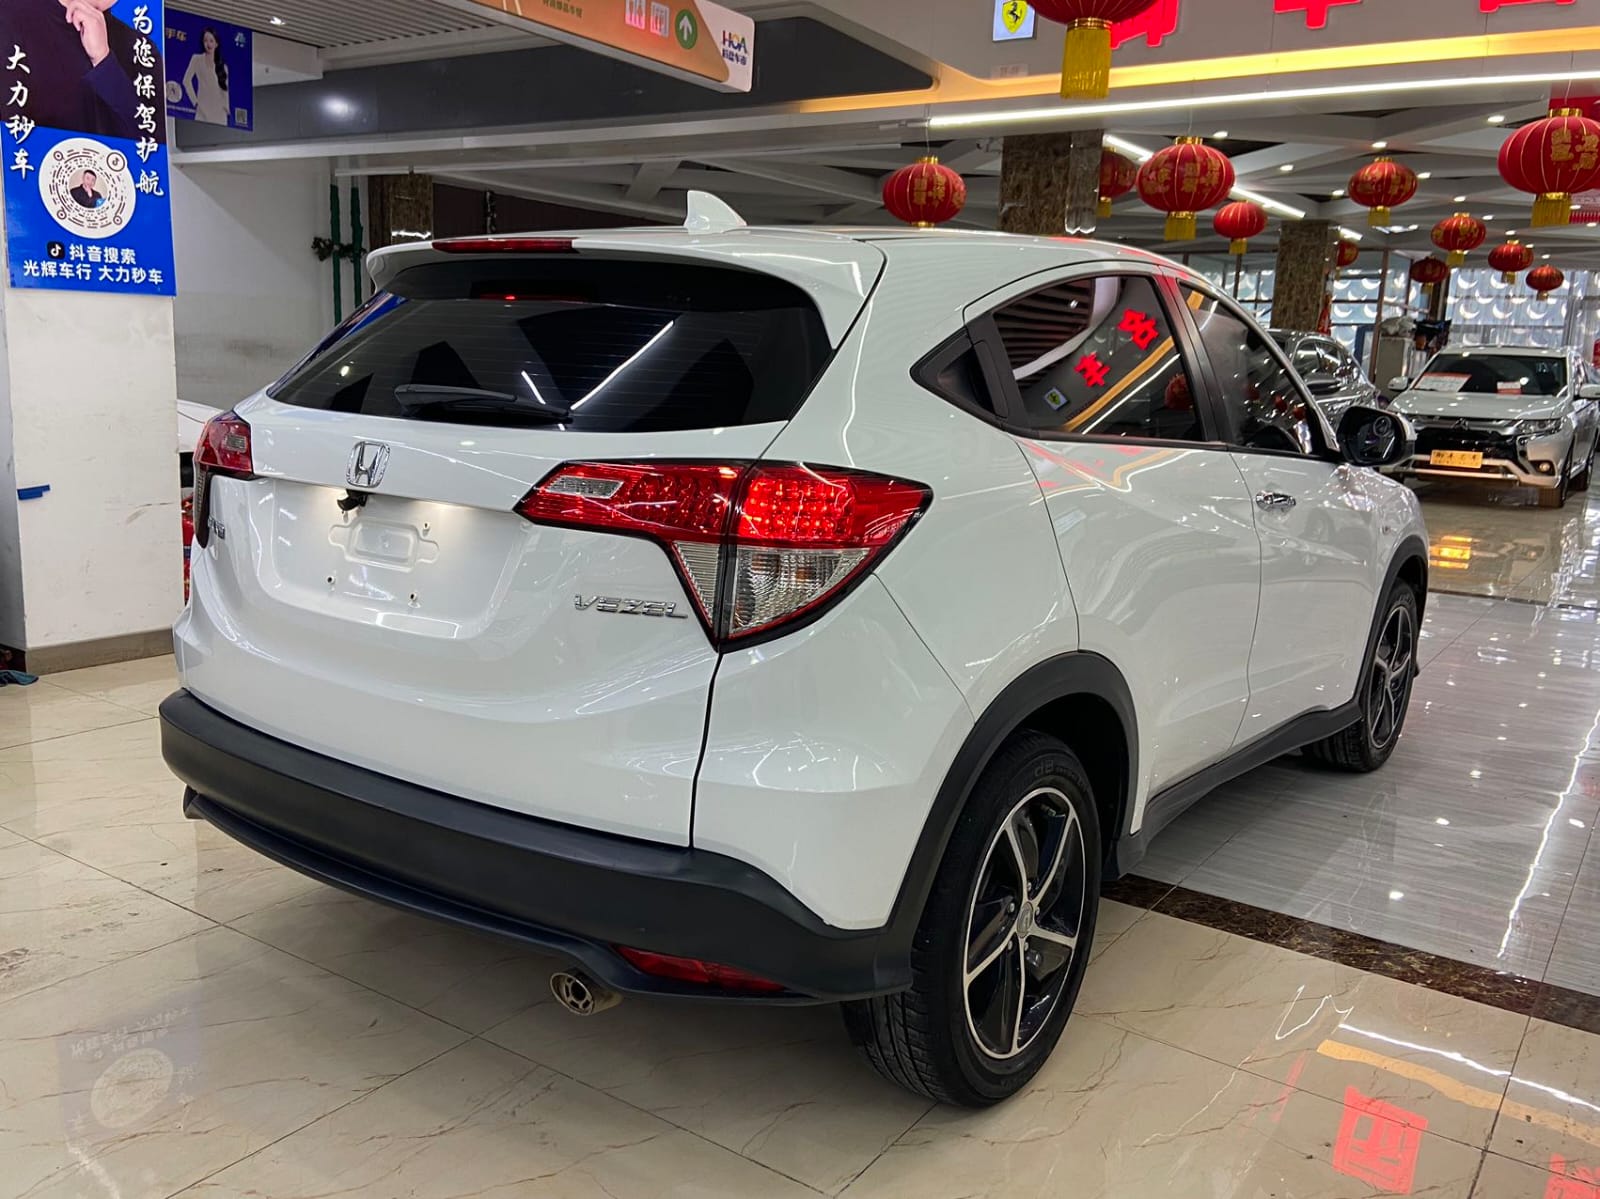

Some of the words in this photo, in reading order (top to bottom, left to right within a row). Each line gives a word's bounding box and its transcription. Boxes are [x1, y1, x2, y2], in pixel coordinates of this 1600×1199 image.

[5, 44, 35, 180] 大力秒车
[132, 4, 164, 197] 为您保驾护航
[69, 243, 136, 265] 抖音搜索
[23, 259, 92, 281] 光辉车行
[98, 265, 164, 285] 大力秒车
[575, 594, 688, 619] VEZEL
